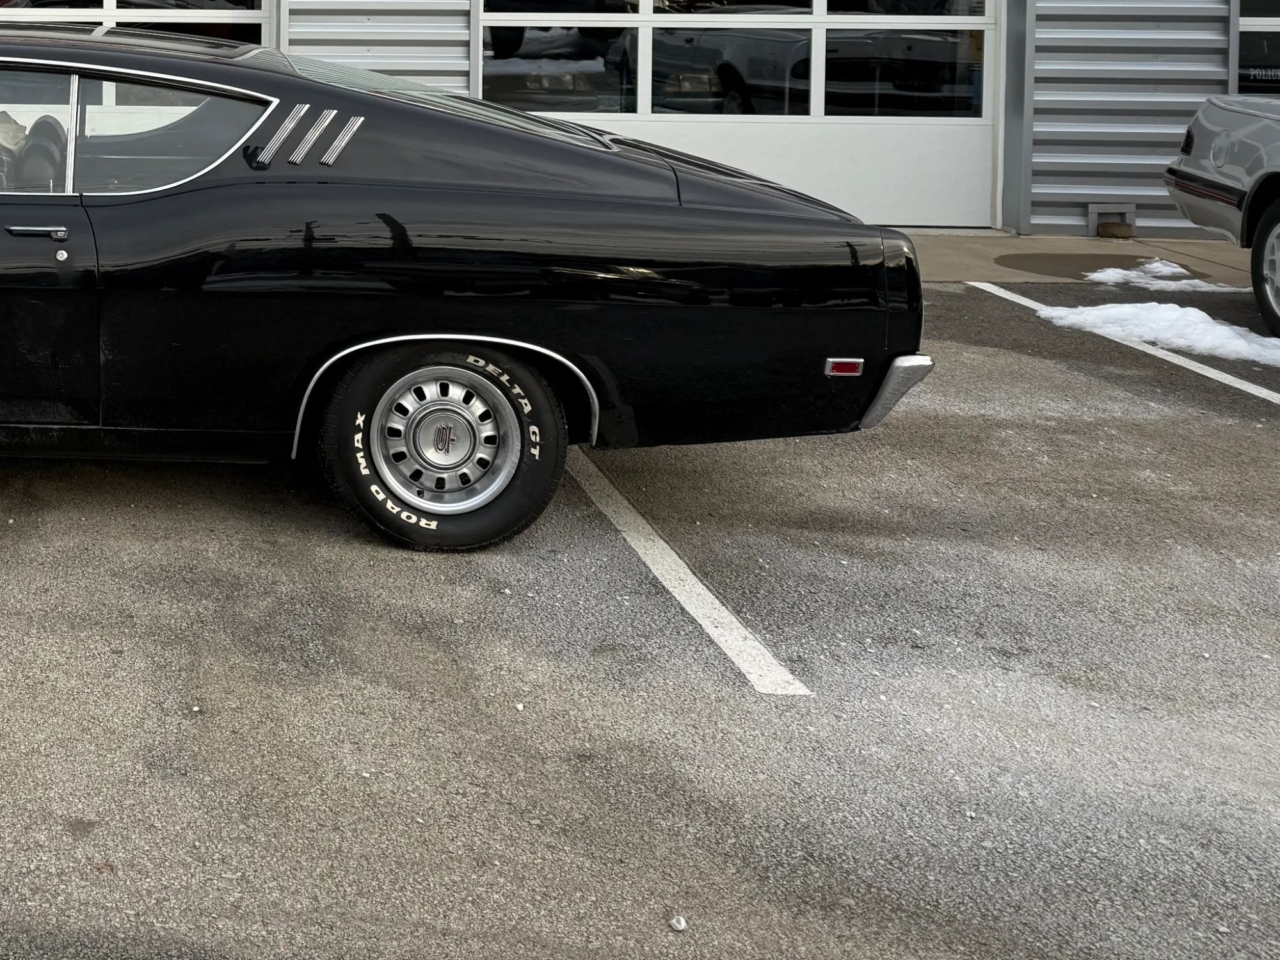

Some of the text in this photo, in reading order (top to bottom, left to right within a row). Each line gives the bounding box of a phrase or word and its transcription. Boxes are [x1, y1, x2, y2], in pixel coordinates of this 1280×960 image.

[466, 355, 541, 460] DELTA GT
[354, 411, 439, 530] ROAD MAX
